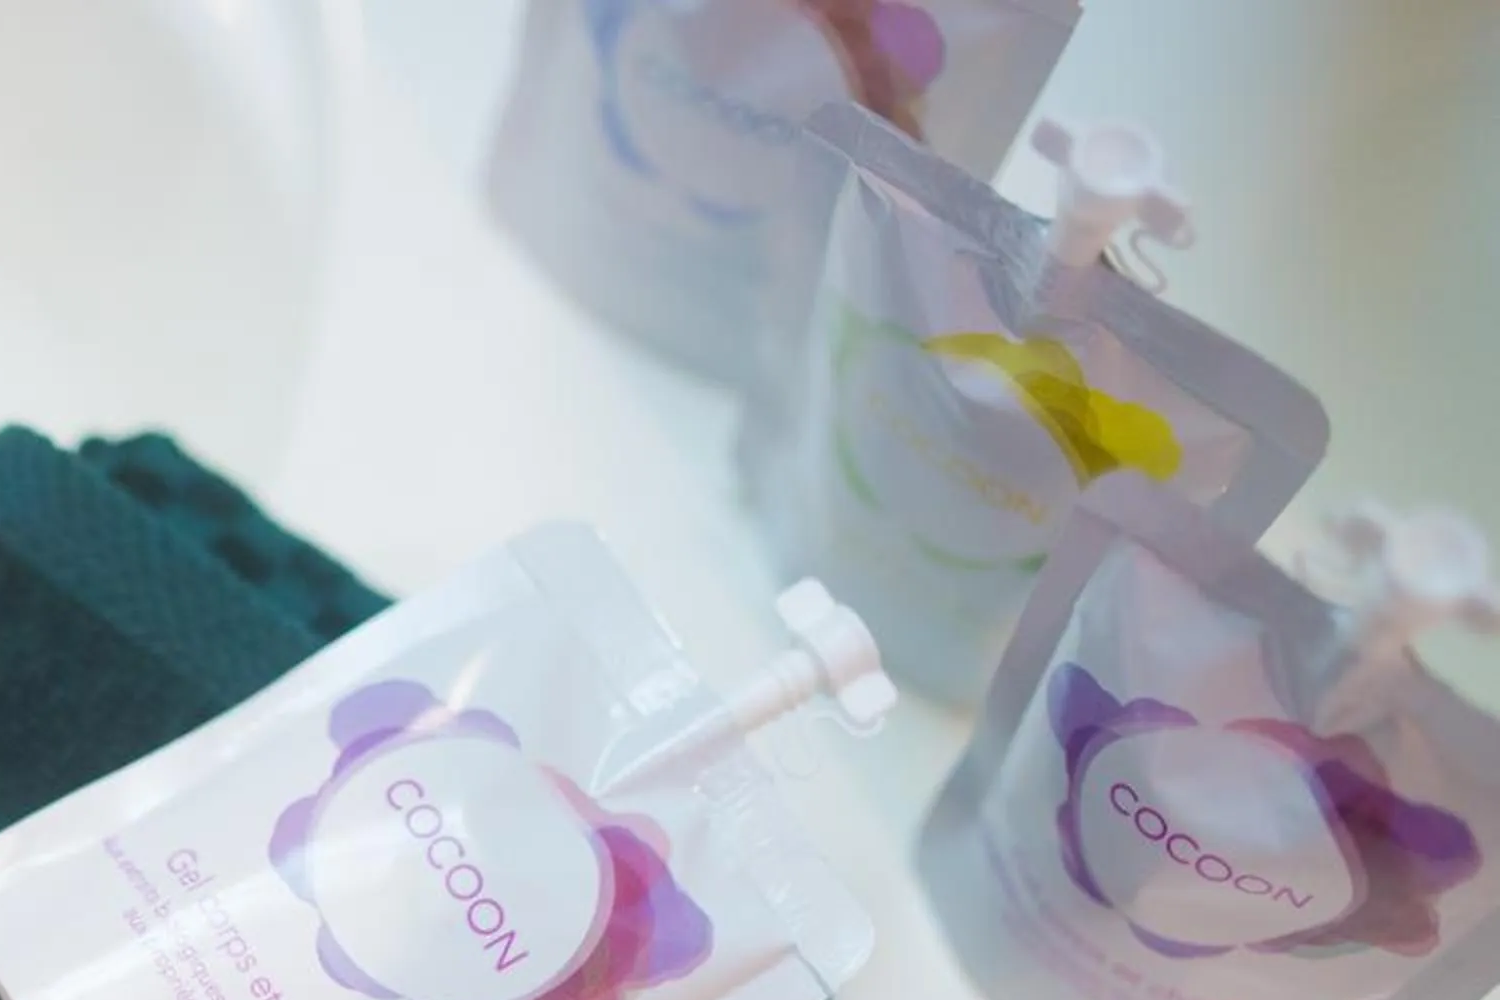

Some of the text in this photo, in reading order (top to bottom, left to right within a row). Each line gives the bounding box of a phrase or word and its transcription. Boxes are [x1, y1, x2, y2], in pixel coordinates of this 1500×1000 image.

[167, 848, 217, 893] Gel
[386, 778, 530, 974] COCOON
[1109, 782, 1314, 909] COCOON
